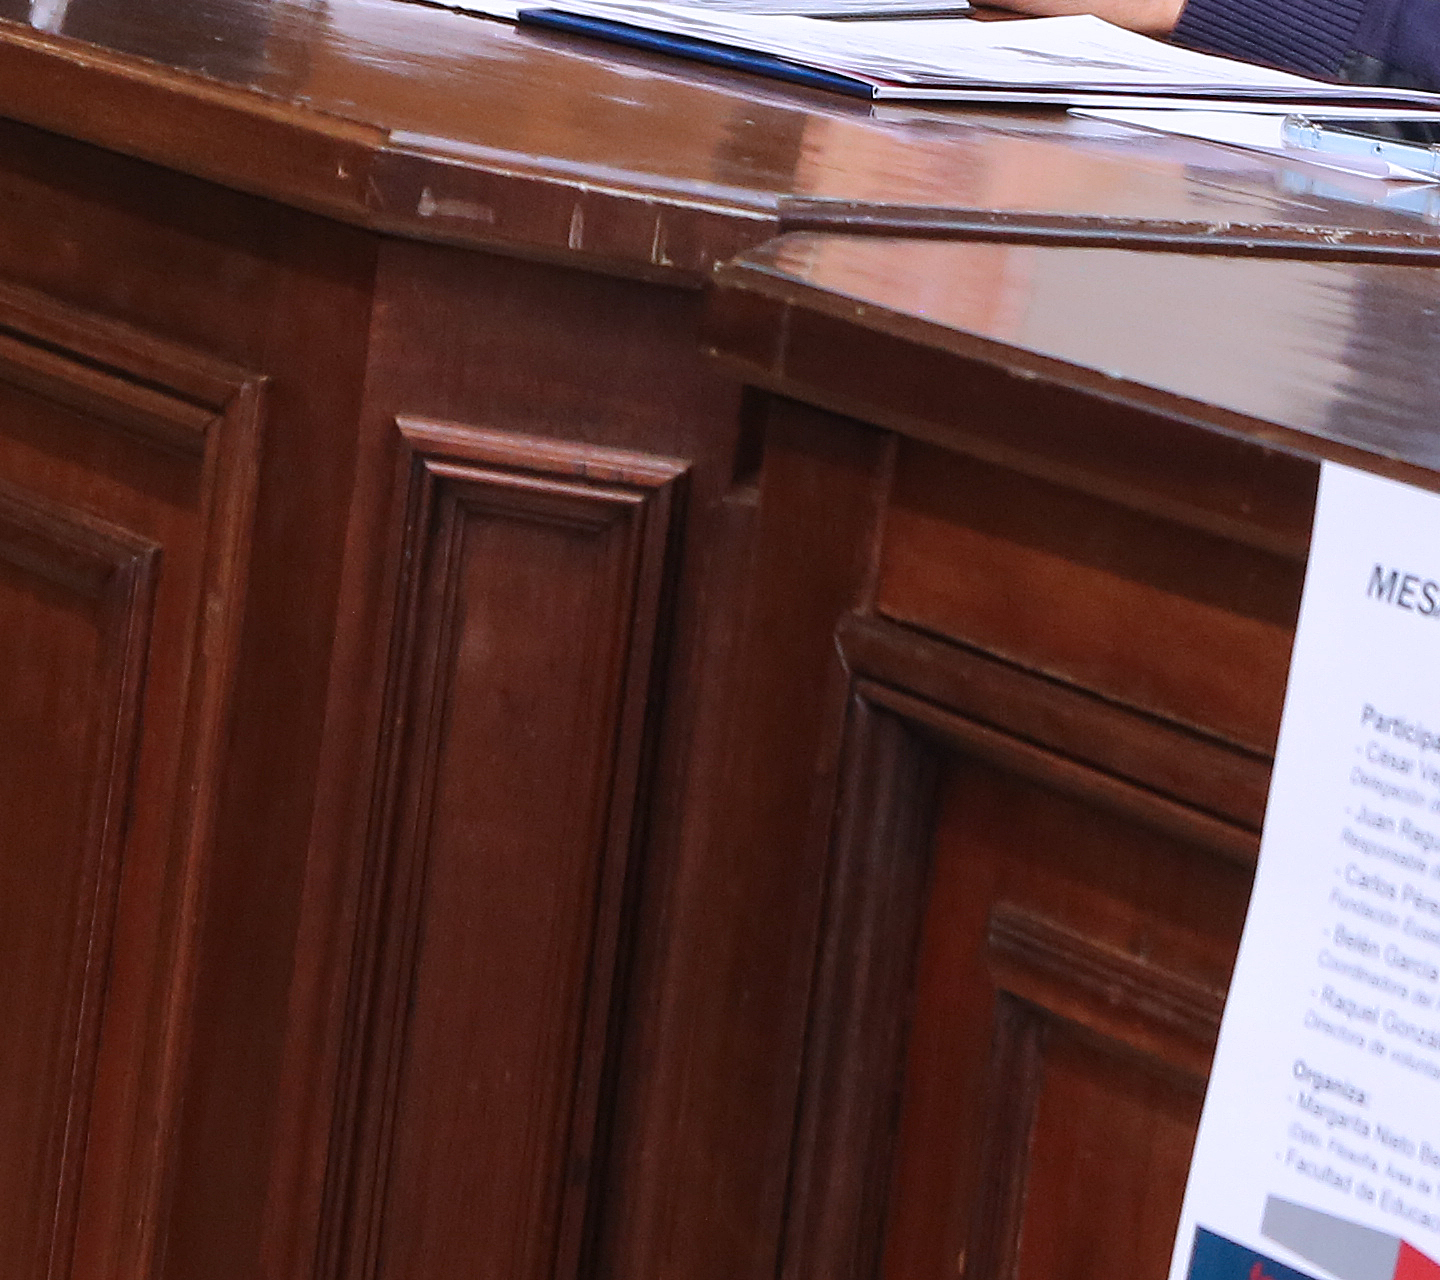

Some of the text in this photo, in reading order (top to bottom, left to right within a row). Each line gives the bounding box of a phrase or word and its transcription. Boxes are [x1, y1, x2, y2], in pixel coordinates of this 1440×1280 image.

[1366, 741, 1414, 775] César
[1355, 805, 1395, 832] Juan
[1333, 923, 1379, 957] Belén
[1383, 943, 1439, 983] García
[1321, 984, 1379, 1024] Raquel
[1293, 1059, 1368, 1106] Organiza:
[1297, 1091, 1370, 1138] Margarita
[1374, 1123, 1415, 1157] Nieto
